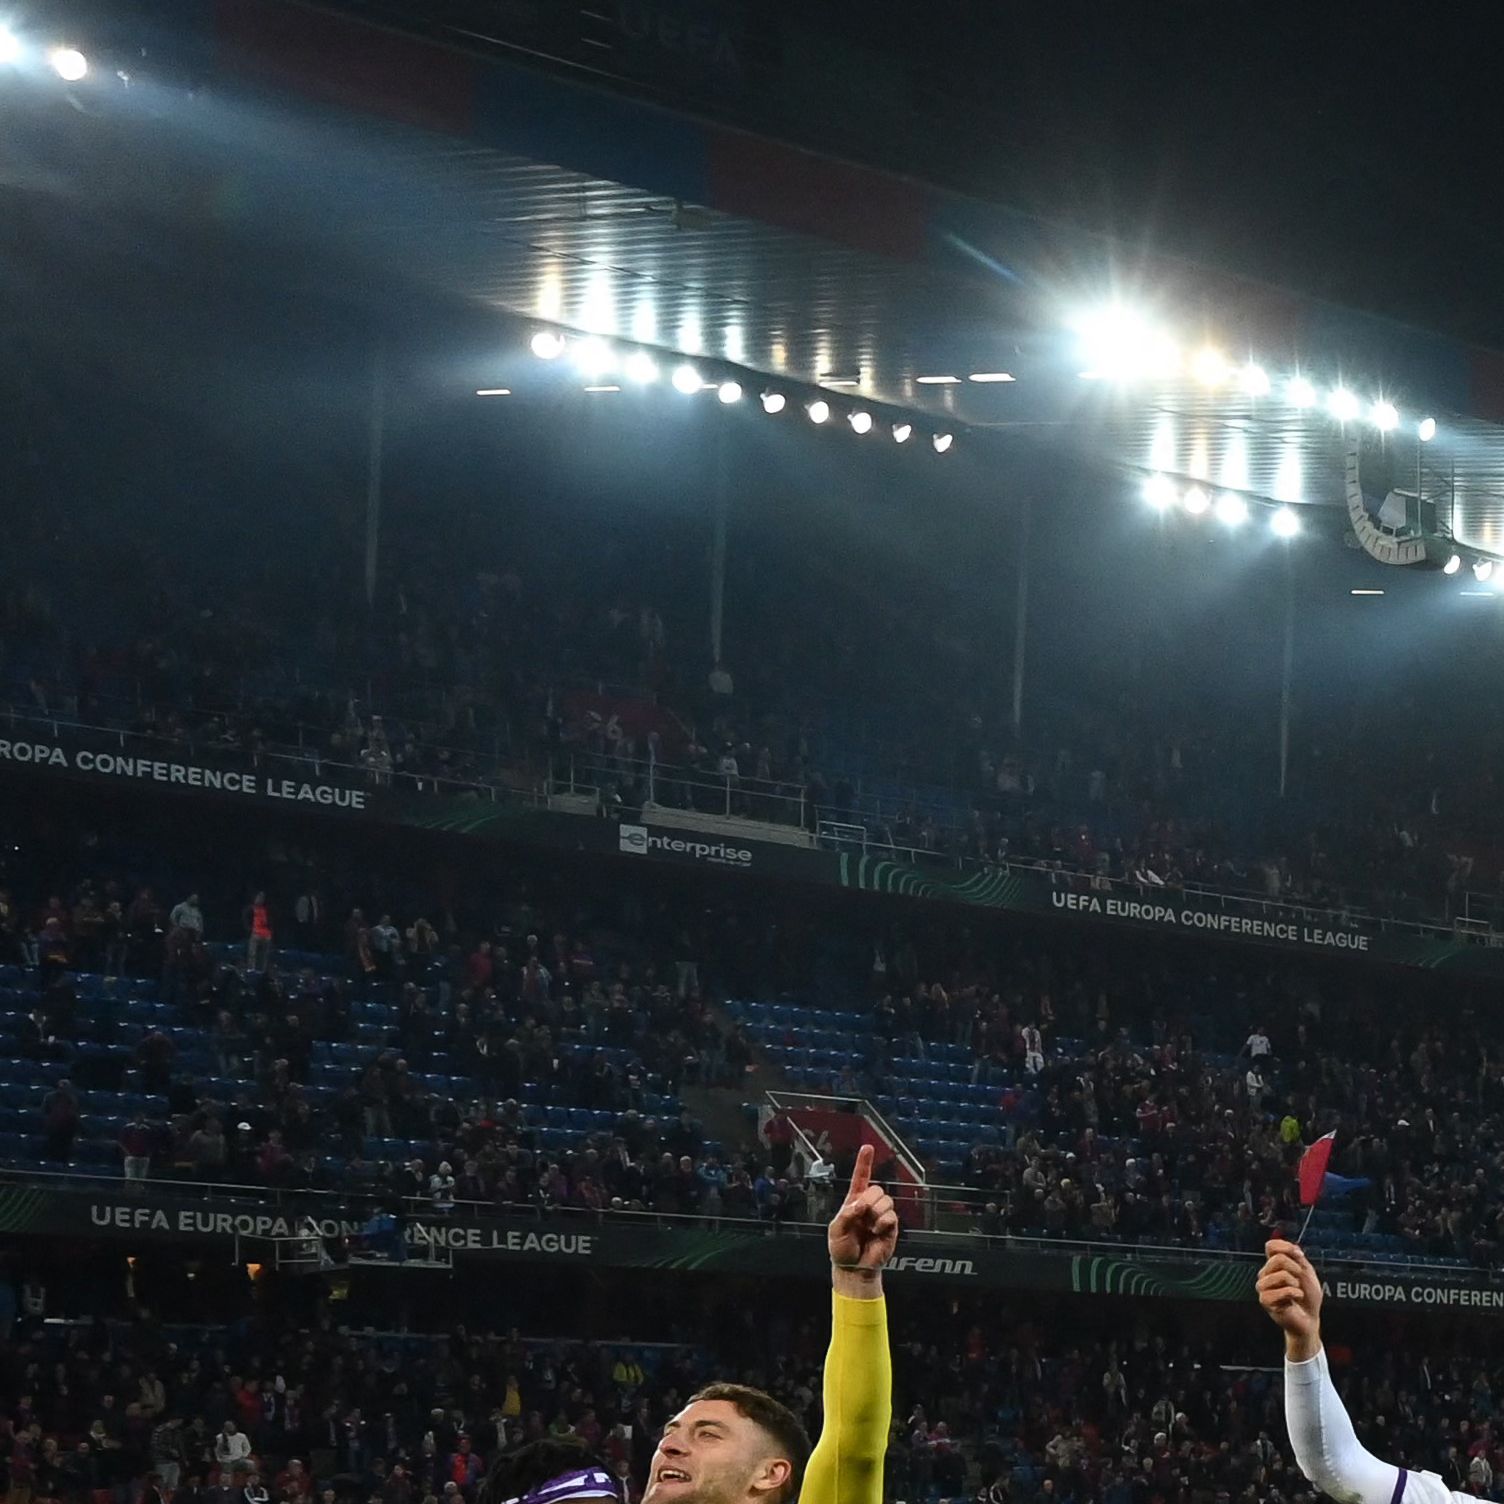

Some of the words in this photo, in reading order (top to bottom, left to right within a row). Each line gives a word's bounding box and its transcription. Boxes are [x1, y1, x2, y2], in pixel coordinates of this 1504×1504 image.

[75, 750, 257, 795] CONFERENCE
[266, 778, 366, 809] LEAGUE
[622, 830, 752, 860] enterprise
[1051, 890, 1101, 914] UEFA
[1105, 899, 1177, 924] EUROPA
[1181, 909, 1299, 942] CONFERENCE
[1303, 927, 1369, 951] LEAGUE
[90, 1204, 170, 1232] UEFA
[178, 1210, 287, 1238] EUROPA
[491, 1230, 593, 1256] LEAGUE
[1336, 1281, 1407, 1303] EUROPA
